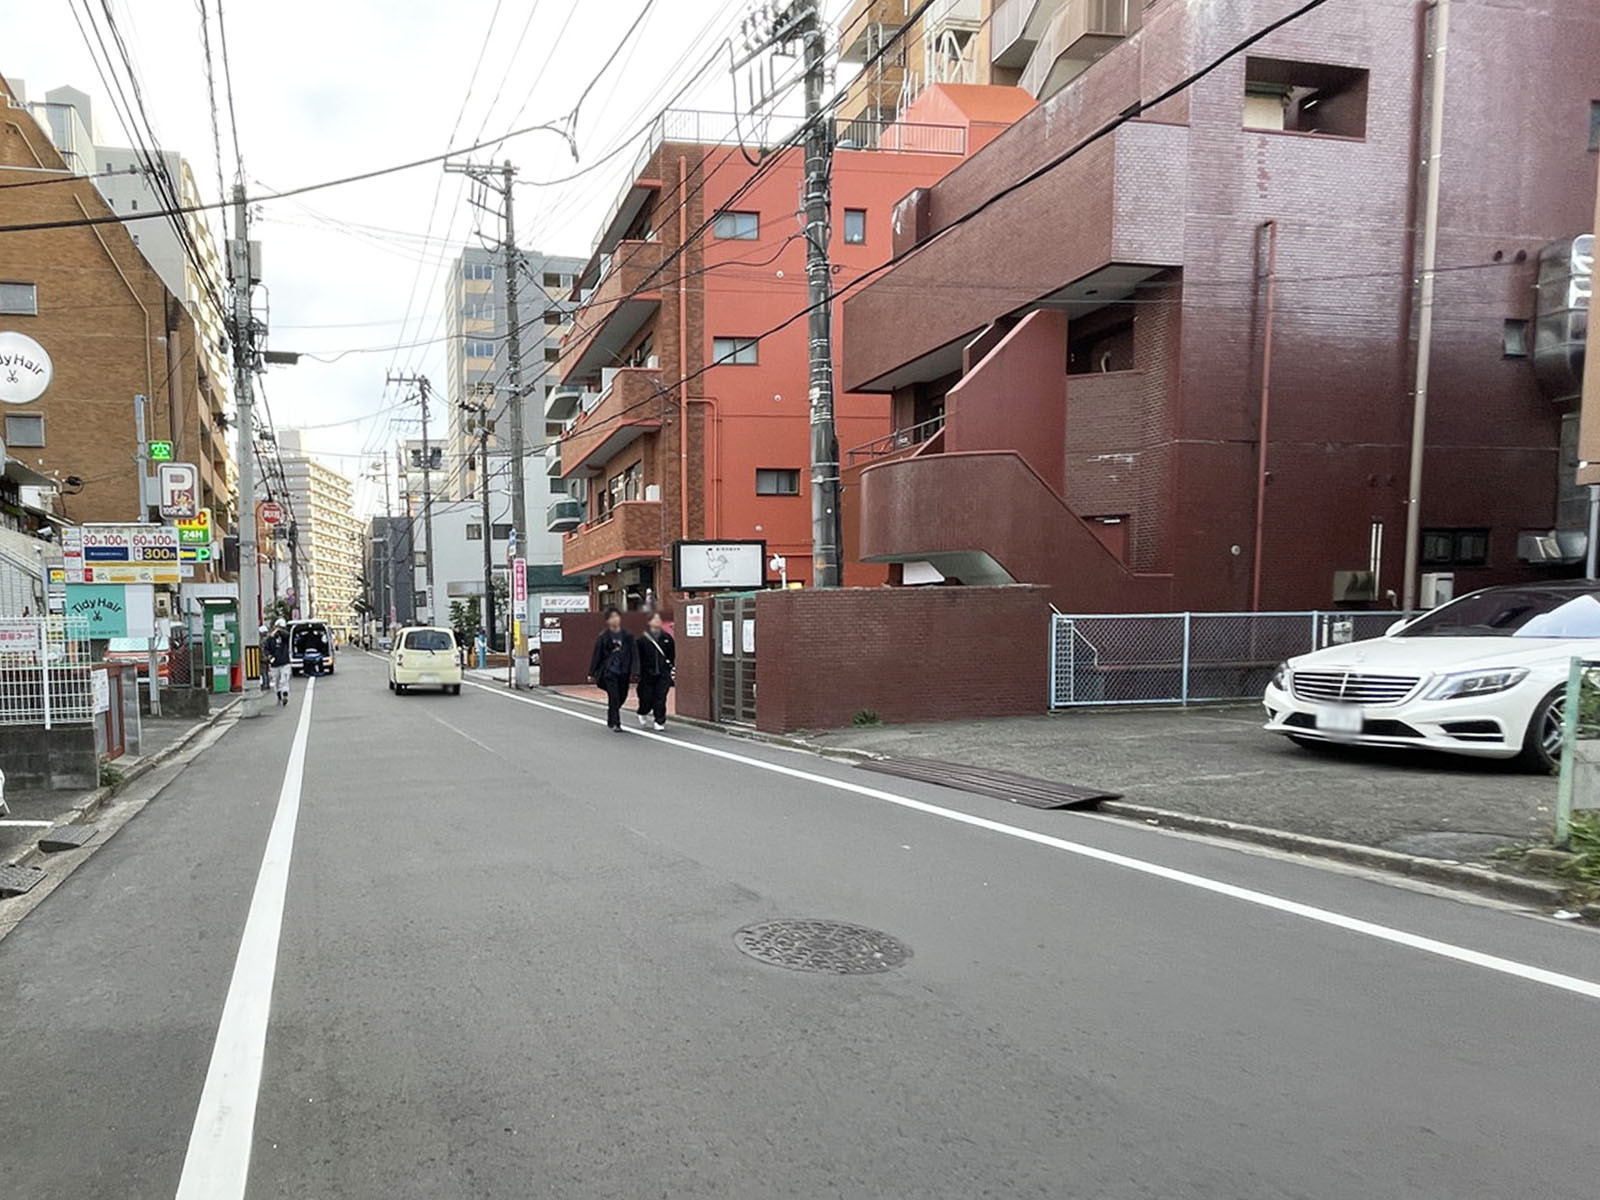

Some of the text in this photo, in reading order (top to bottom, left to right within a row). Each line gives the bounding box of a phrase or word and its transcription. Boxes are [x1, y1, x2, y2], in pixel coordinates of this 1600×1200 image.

[14, 354, 44, 375] Hair
[162, 467, 192, 506] P
[182, 530, 203, 539] 24H
[197, 548, 210, 561] P
[71, 598, 122, 613] Tidy Hair
